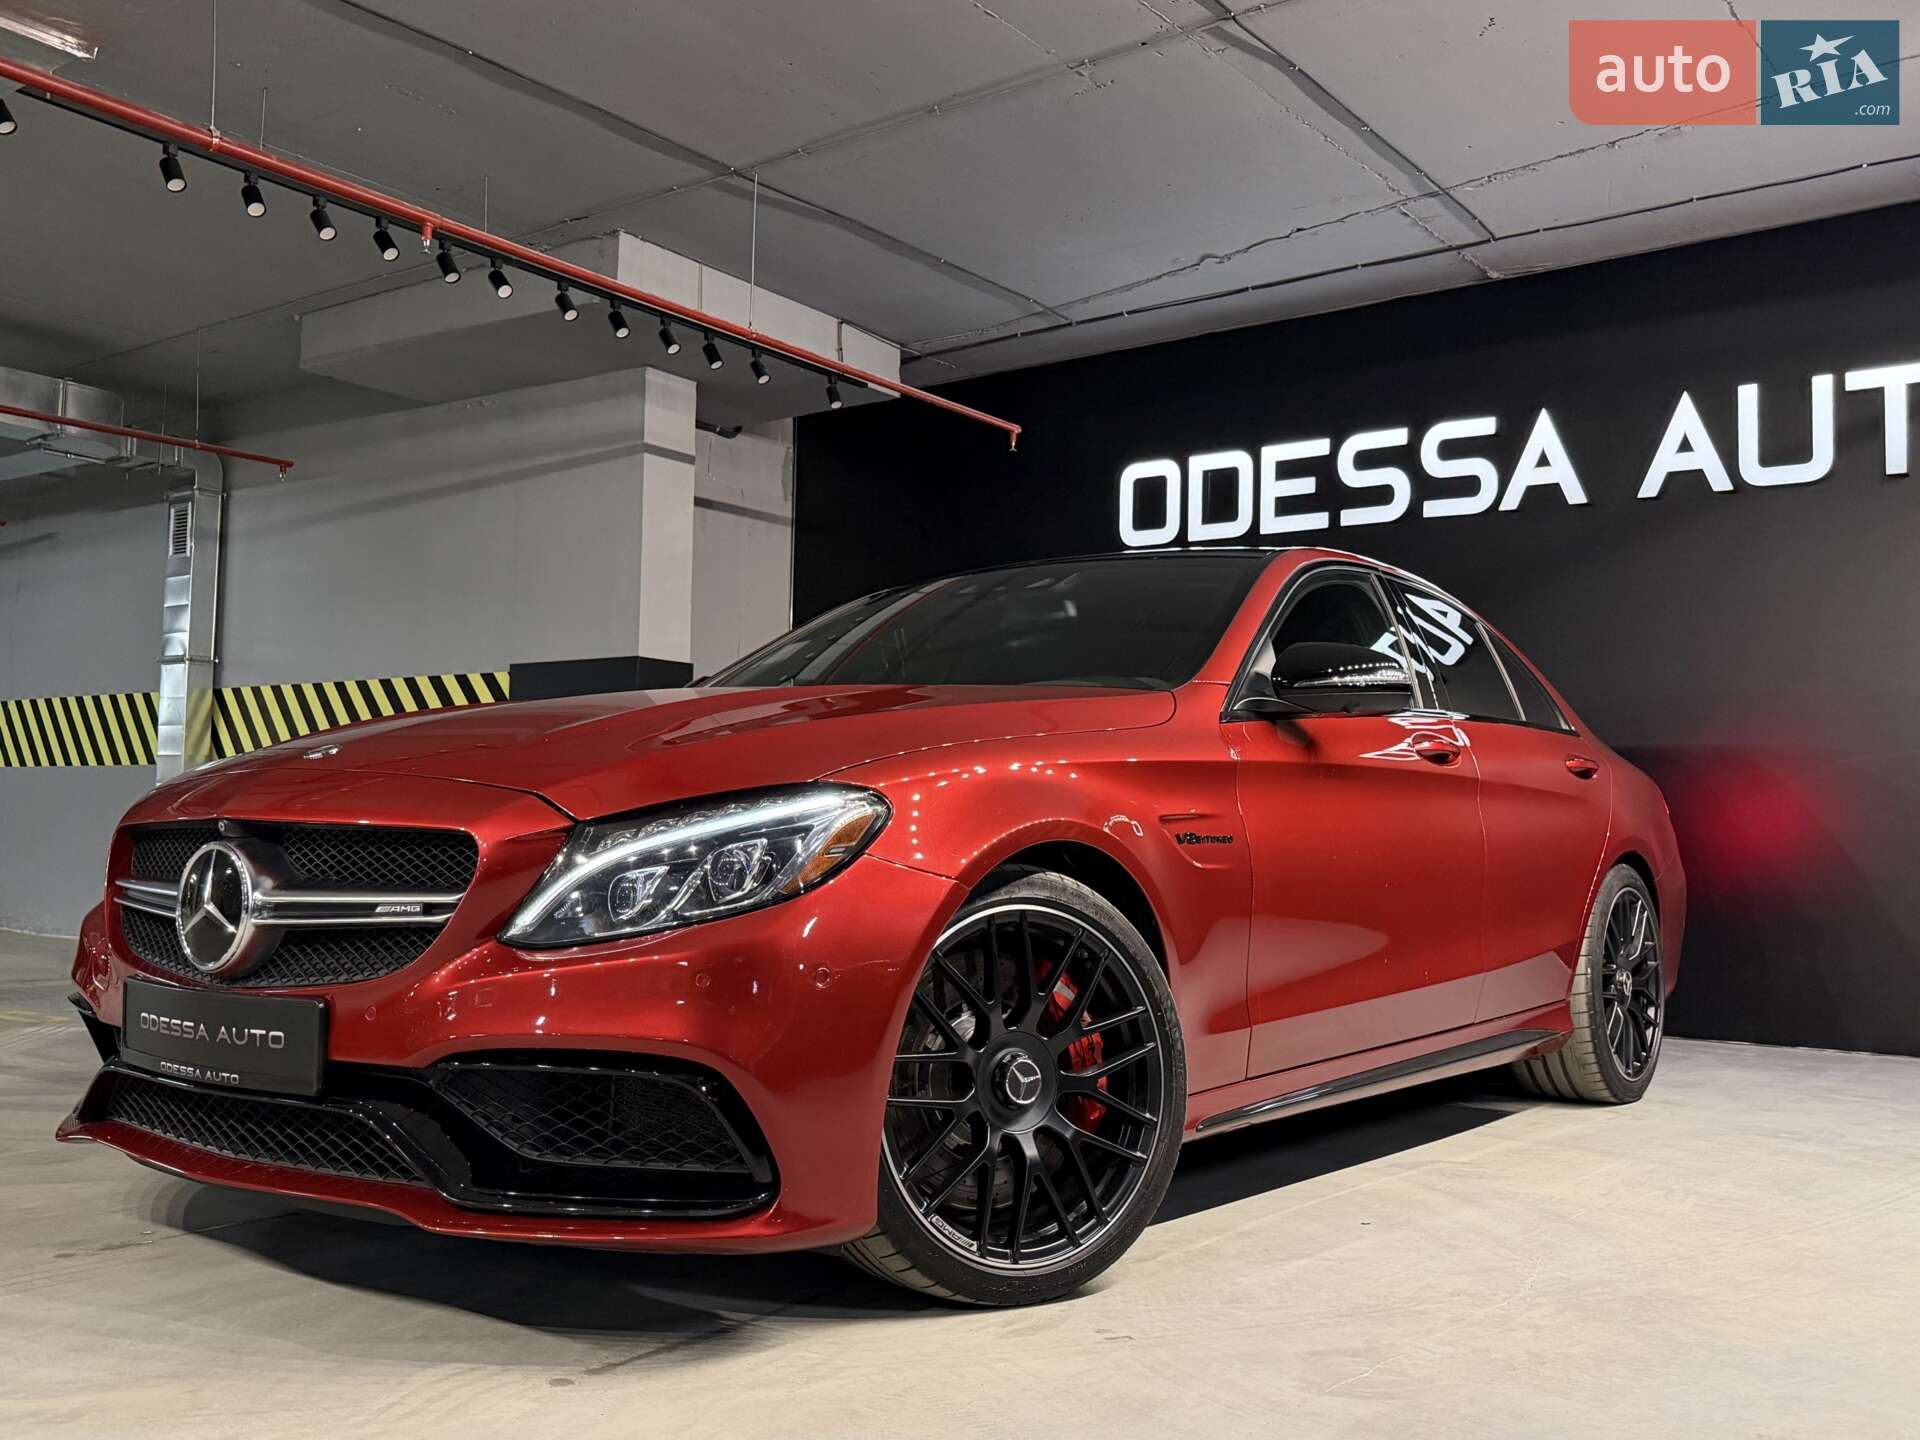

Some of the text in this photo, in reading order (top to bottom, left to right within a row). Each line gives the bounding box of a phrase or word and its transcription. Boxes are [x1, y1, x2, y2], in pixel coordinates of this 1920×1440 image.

[1119, 407, 1589, 546] ODESSA
[389, 905, 421, 913] AMG
[140, 1012, 286, 1049] ODESSA AUTO
[160, 1061, 240, 1085] ODESSA AUTO
